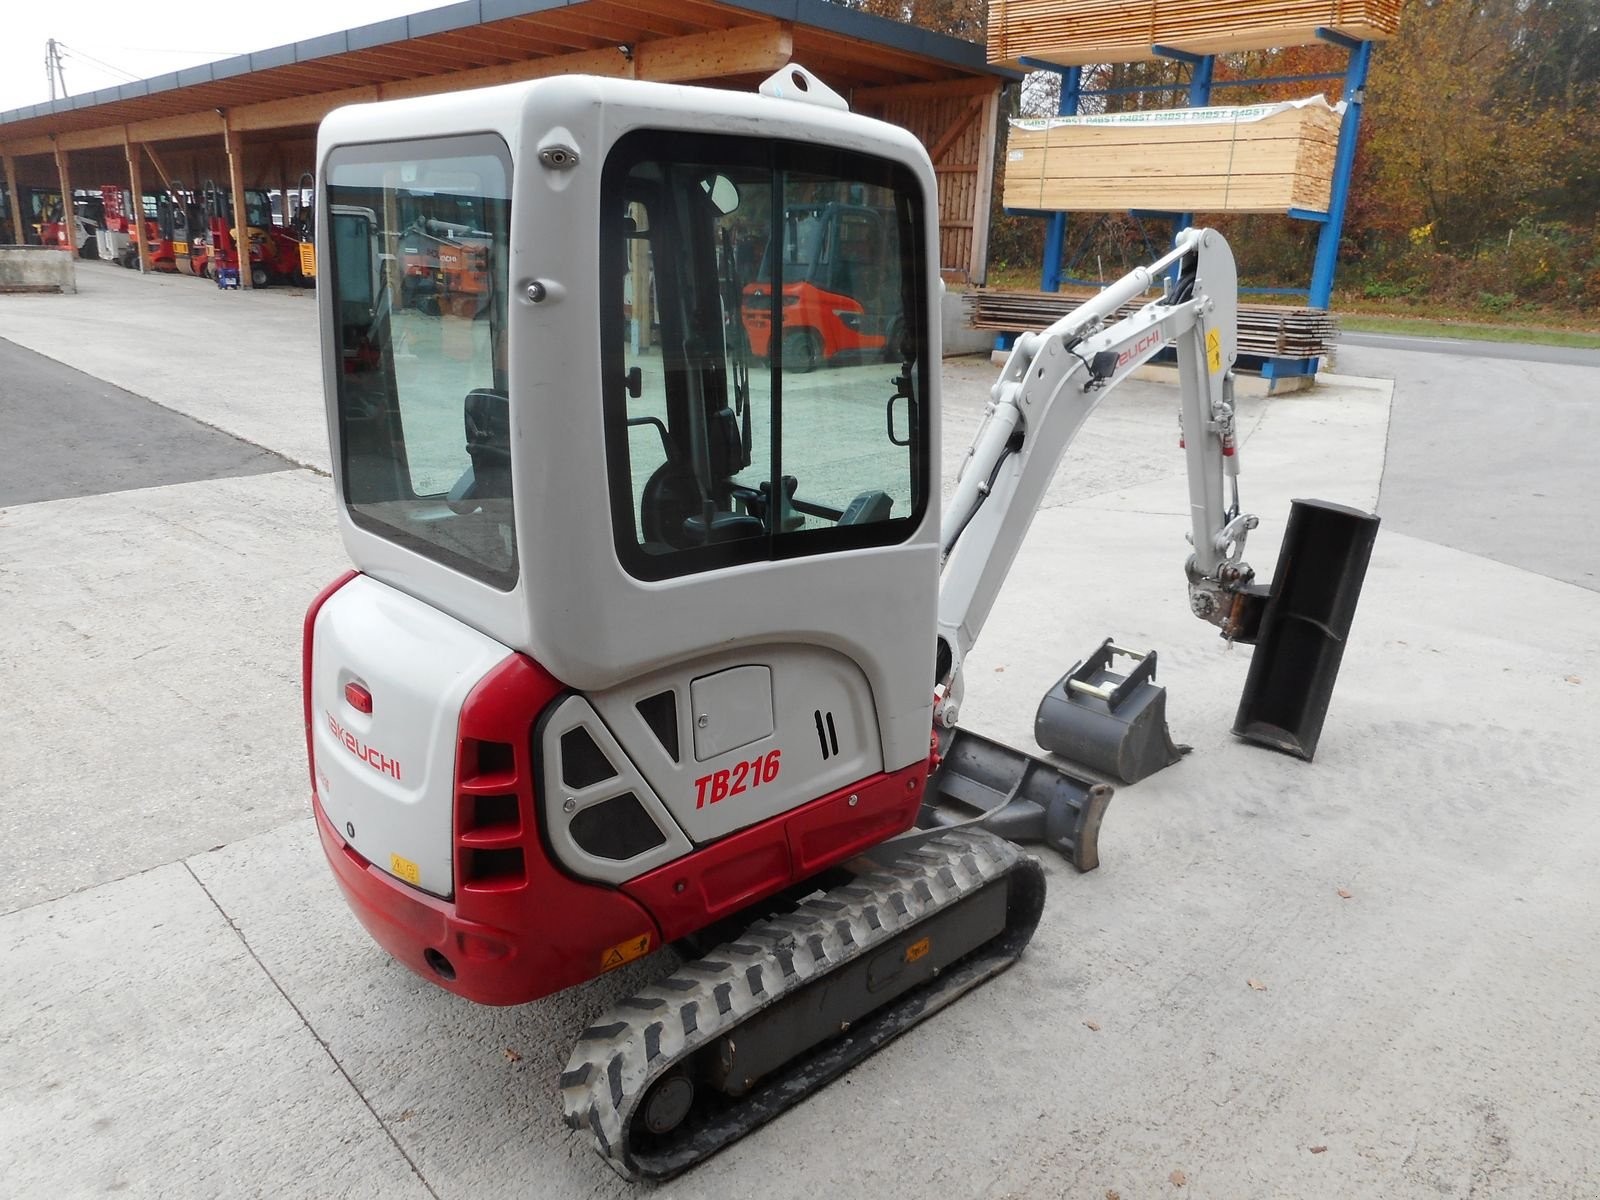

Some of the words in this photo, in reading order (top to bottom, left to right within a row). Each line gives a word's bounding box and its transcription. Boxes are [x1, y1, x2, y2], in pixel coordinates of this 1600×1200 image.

[1085, 114, 1115, 124] PABST
[1119, 113, 1152, 123] PABST
[1154, 111, 1188, 121] PABST
[1191, 109, 1226, 119] PABST
[1114, 329, 1159, 370] EUCHI
[694, 749, 782, 810] TB216
